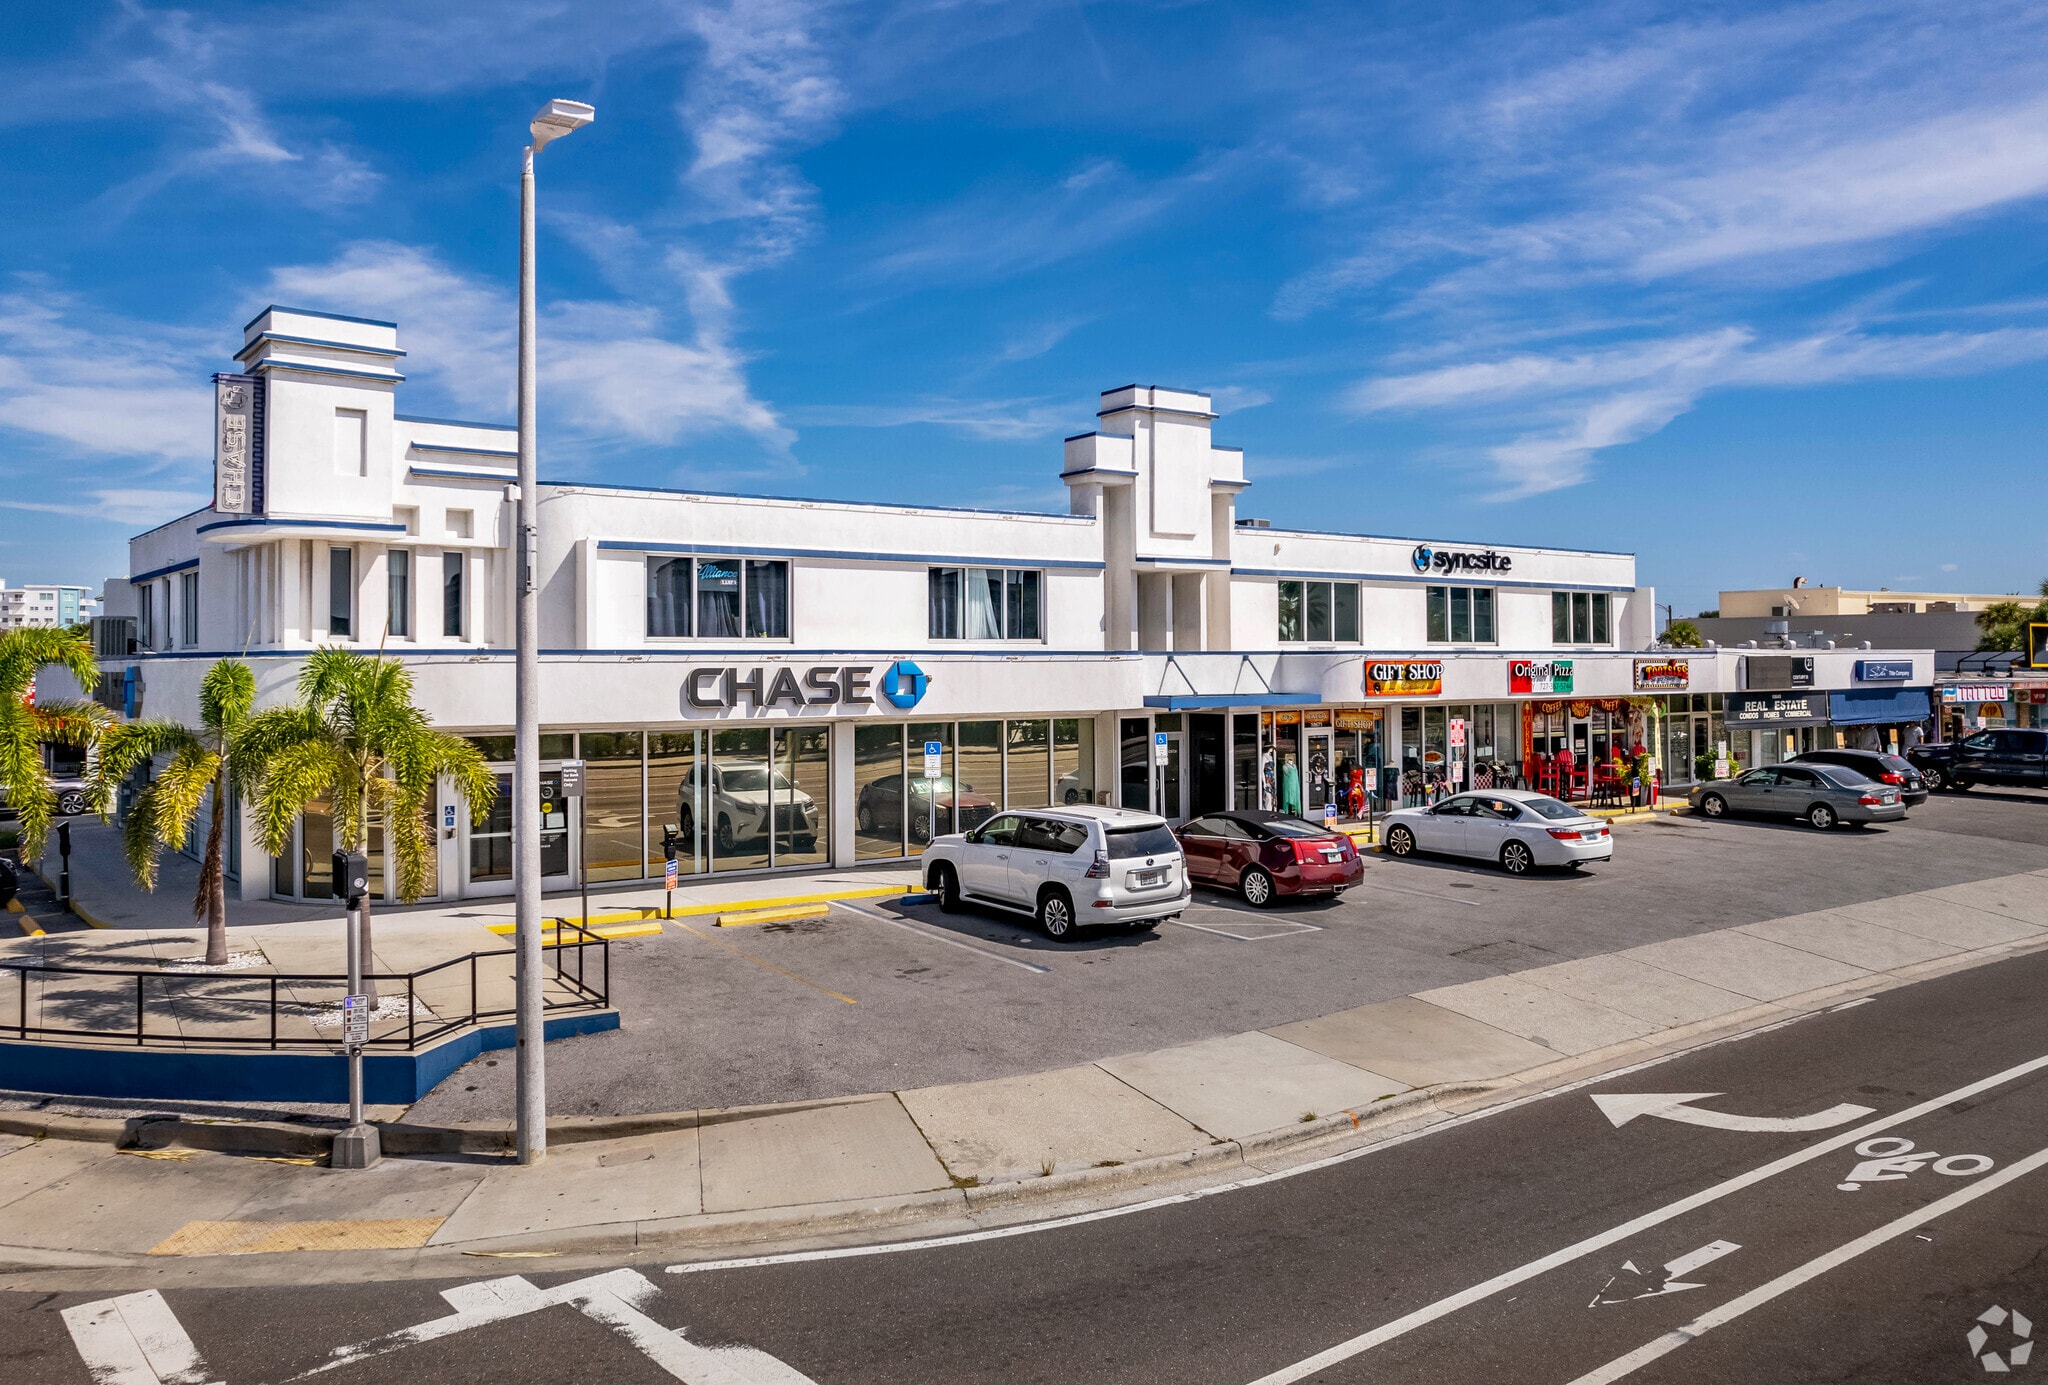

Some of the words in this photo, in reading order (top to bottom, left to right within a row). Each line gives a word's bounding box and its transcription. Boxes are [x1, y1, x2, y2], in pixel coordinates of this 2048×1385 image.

[224, 414, 247, 505] CHASE
[1433, 551, 1512, 574] syncsite
[698, 563, 738, 580] Alliance
[1374, 663, 1404, 681] GIFT
[1409, 663, 1444, 681] SHOP
[1515, 663, 1551, 678] Original
[1554, 663, 1574, 676] Pizza
[1645, 664, 1688, 681] TOOTSIES
[687, 666, 876, 708] CHASE
[1958, 684, 2006, 701] TATTOO
[1541, 701, 1563, 713] COFFEE
[1601, 699, 1619, 711] TAFFY
[1744, 701, 1768, 712] REAL
[1774, 699, 1808, 711] ESTATE
[1739, 712, 1759, 720] CONDOS
[1763, 711, 1780, 719] HOMES
[1784, 710, 1812, 718] COMMERCIAL
[1335, 719, 1351, 728] GIFT
[1353, 720, 1373, 729] SHOP
